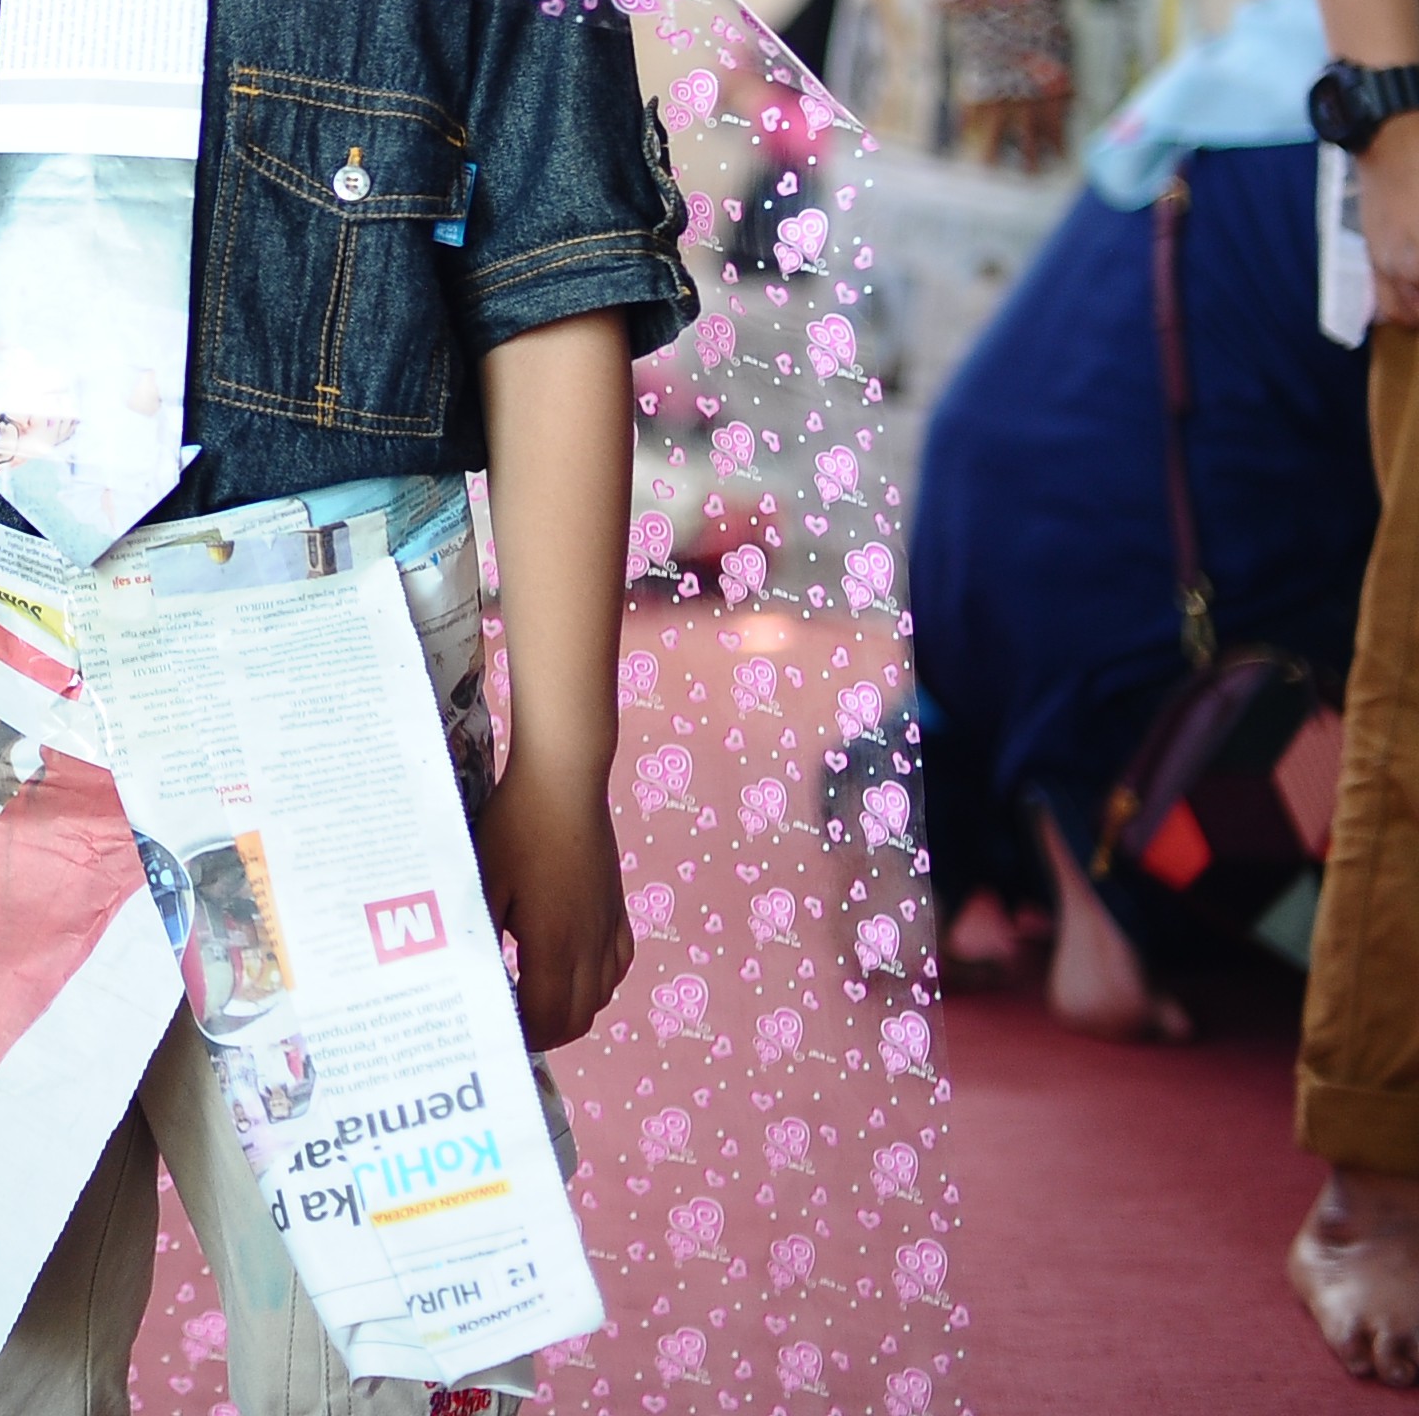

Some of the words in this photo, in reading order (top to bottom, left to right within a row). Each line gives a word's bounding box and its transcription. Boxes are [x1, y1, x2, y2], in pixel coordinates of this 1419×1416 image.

[369, 1005, 413, 1028] warga
[415, 991, 463, 1018] pilihan
[402, 1015, 451, 1039] negara
[437, 1030, 471, 1048] yang
[352, 1054, 388, 1074] lama
[390, 1042, 435, 1066] sudah
[392, 1050, 476, 1083] Pendekatan
[346, 1069, 390, 1093] sajian
[438, 1181, 506, 1208] TAWARAN
